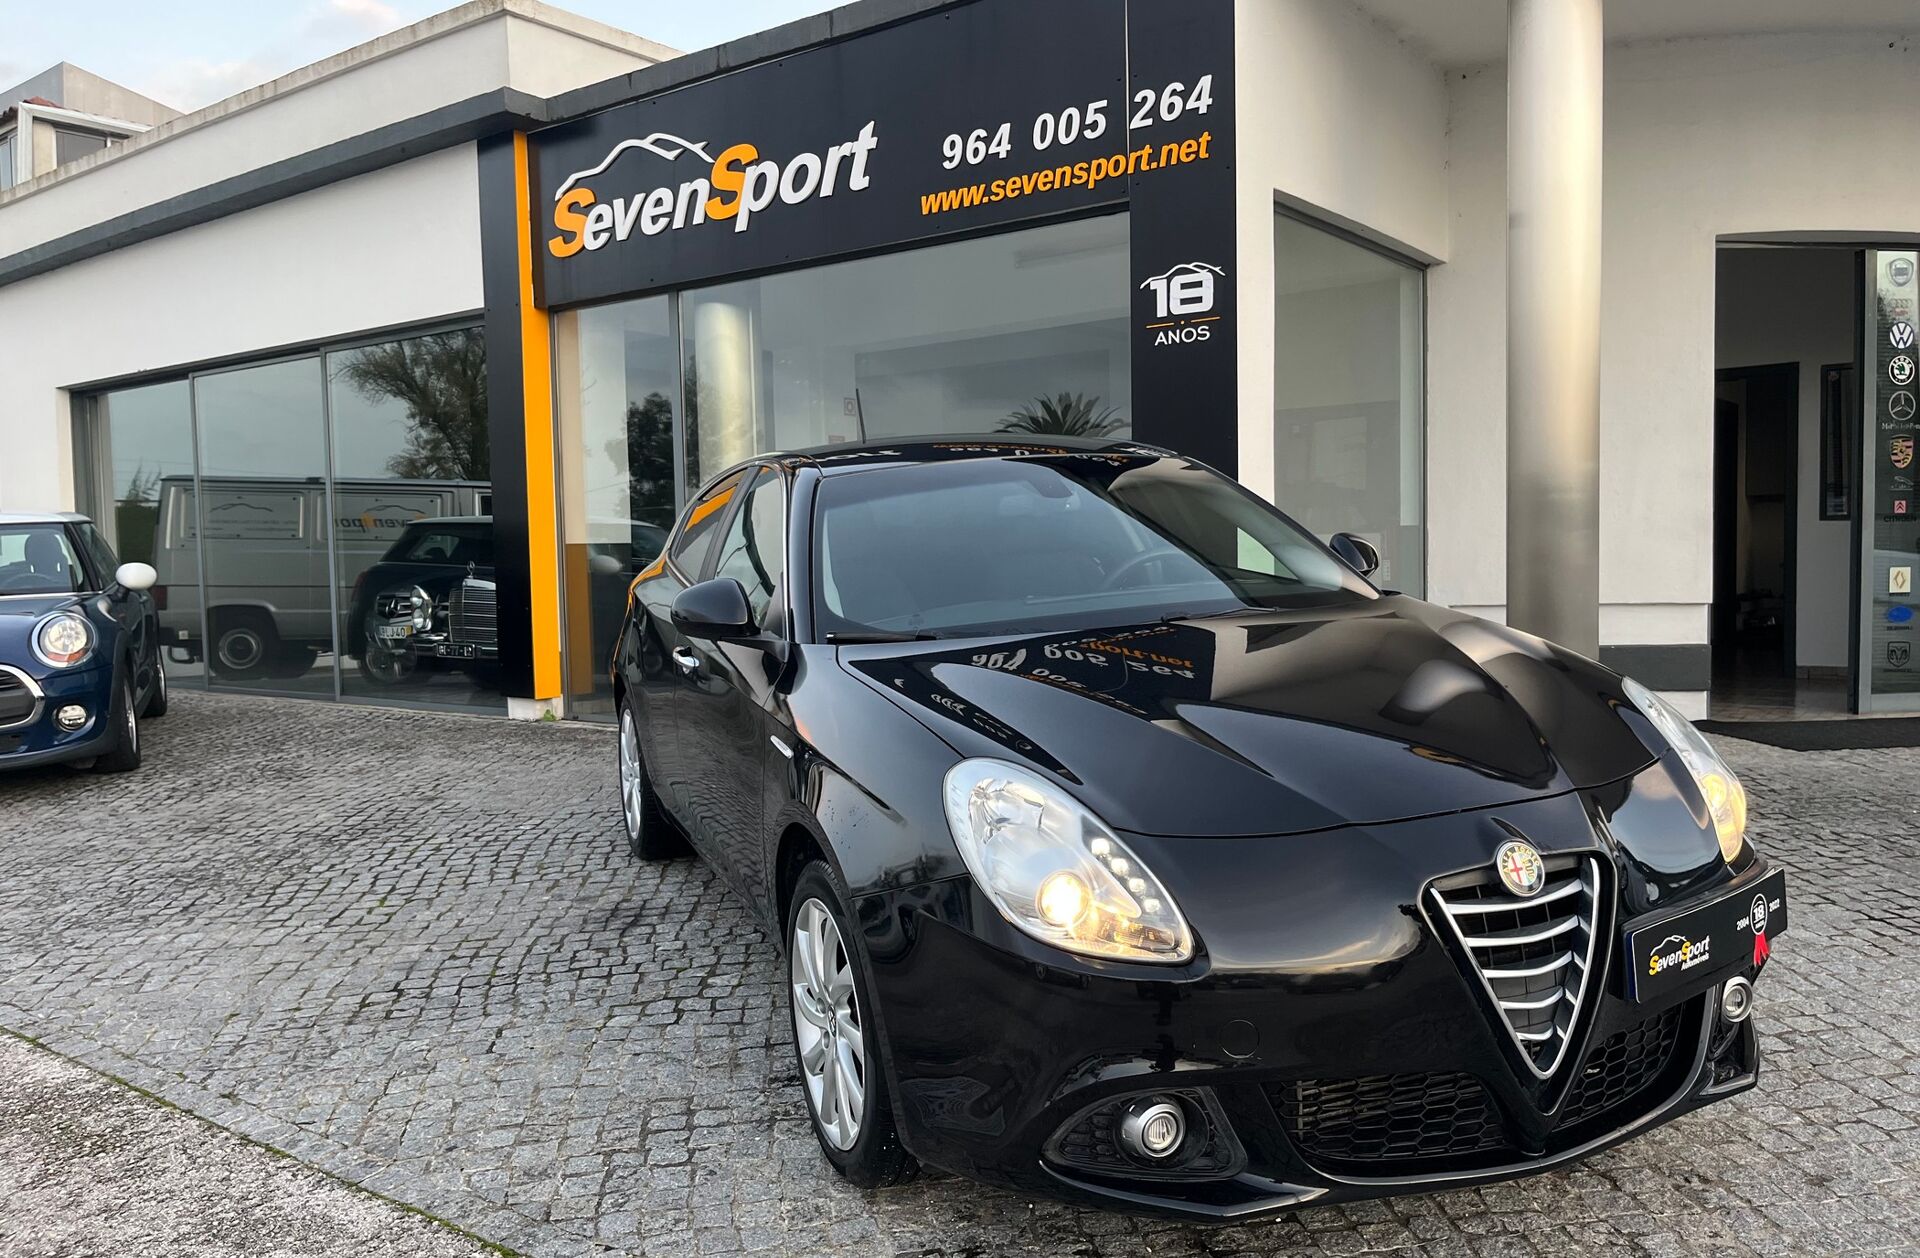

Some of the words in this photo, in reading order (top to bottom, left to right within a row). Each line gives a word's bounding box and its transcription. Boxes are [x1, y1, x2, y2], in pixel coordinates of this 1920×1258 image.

[942, 122, 1012, 170] 964
[1032, 99, 1108, 151] 005
[1129, 74, 1213, 130] 264
[548, 121, 878, 258] SevenSport
[920, 131, 1212, 216] www.sevensport.net
[1149, 271, 1214, 318] 18
[1154, 325, 1211, 346] ANOS
[1753, 904, 1765, 921] 18
[1649, 935, 1710, 976] SevenSport
